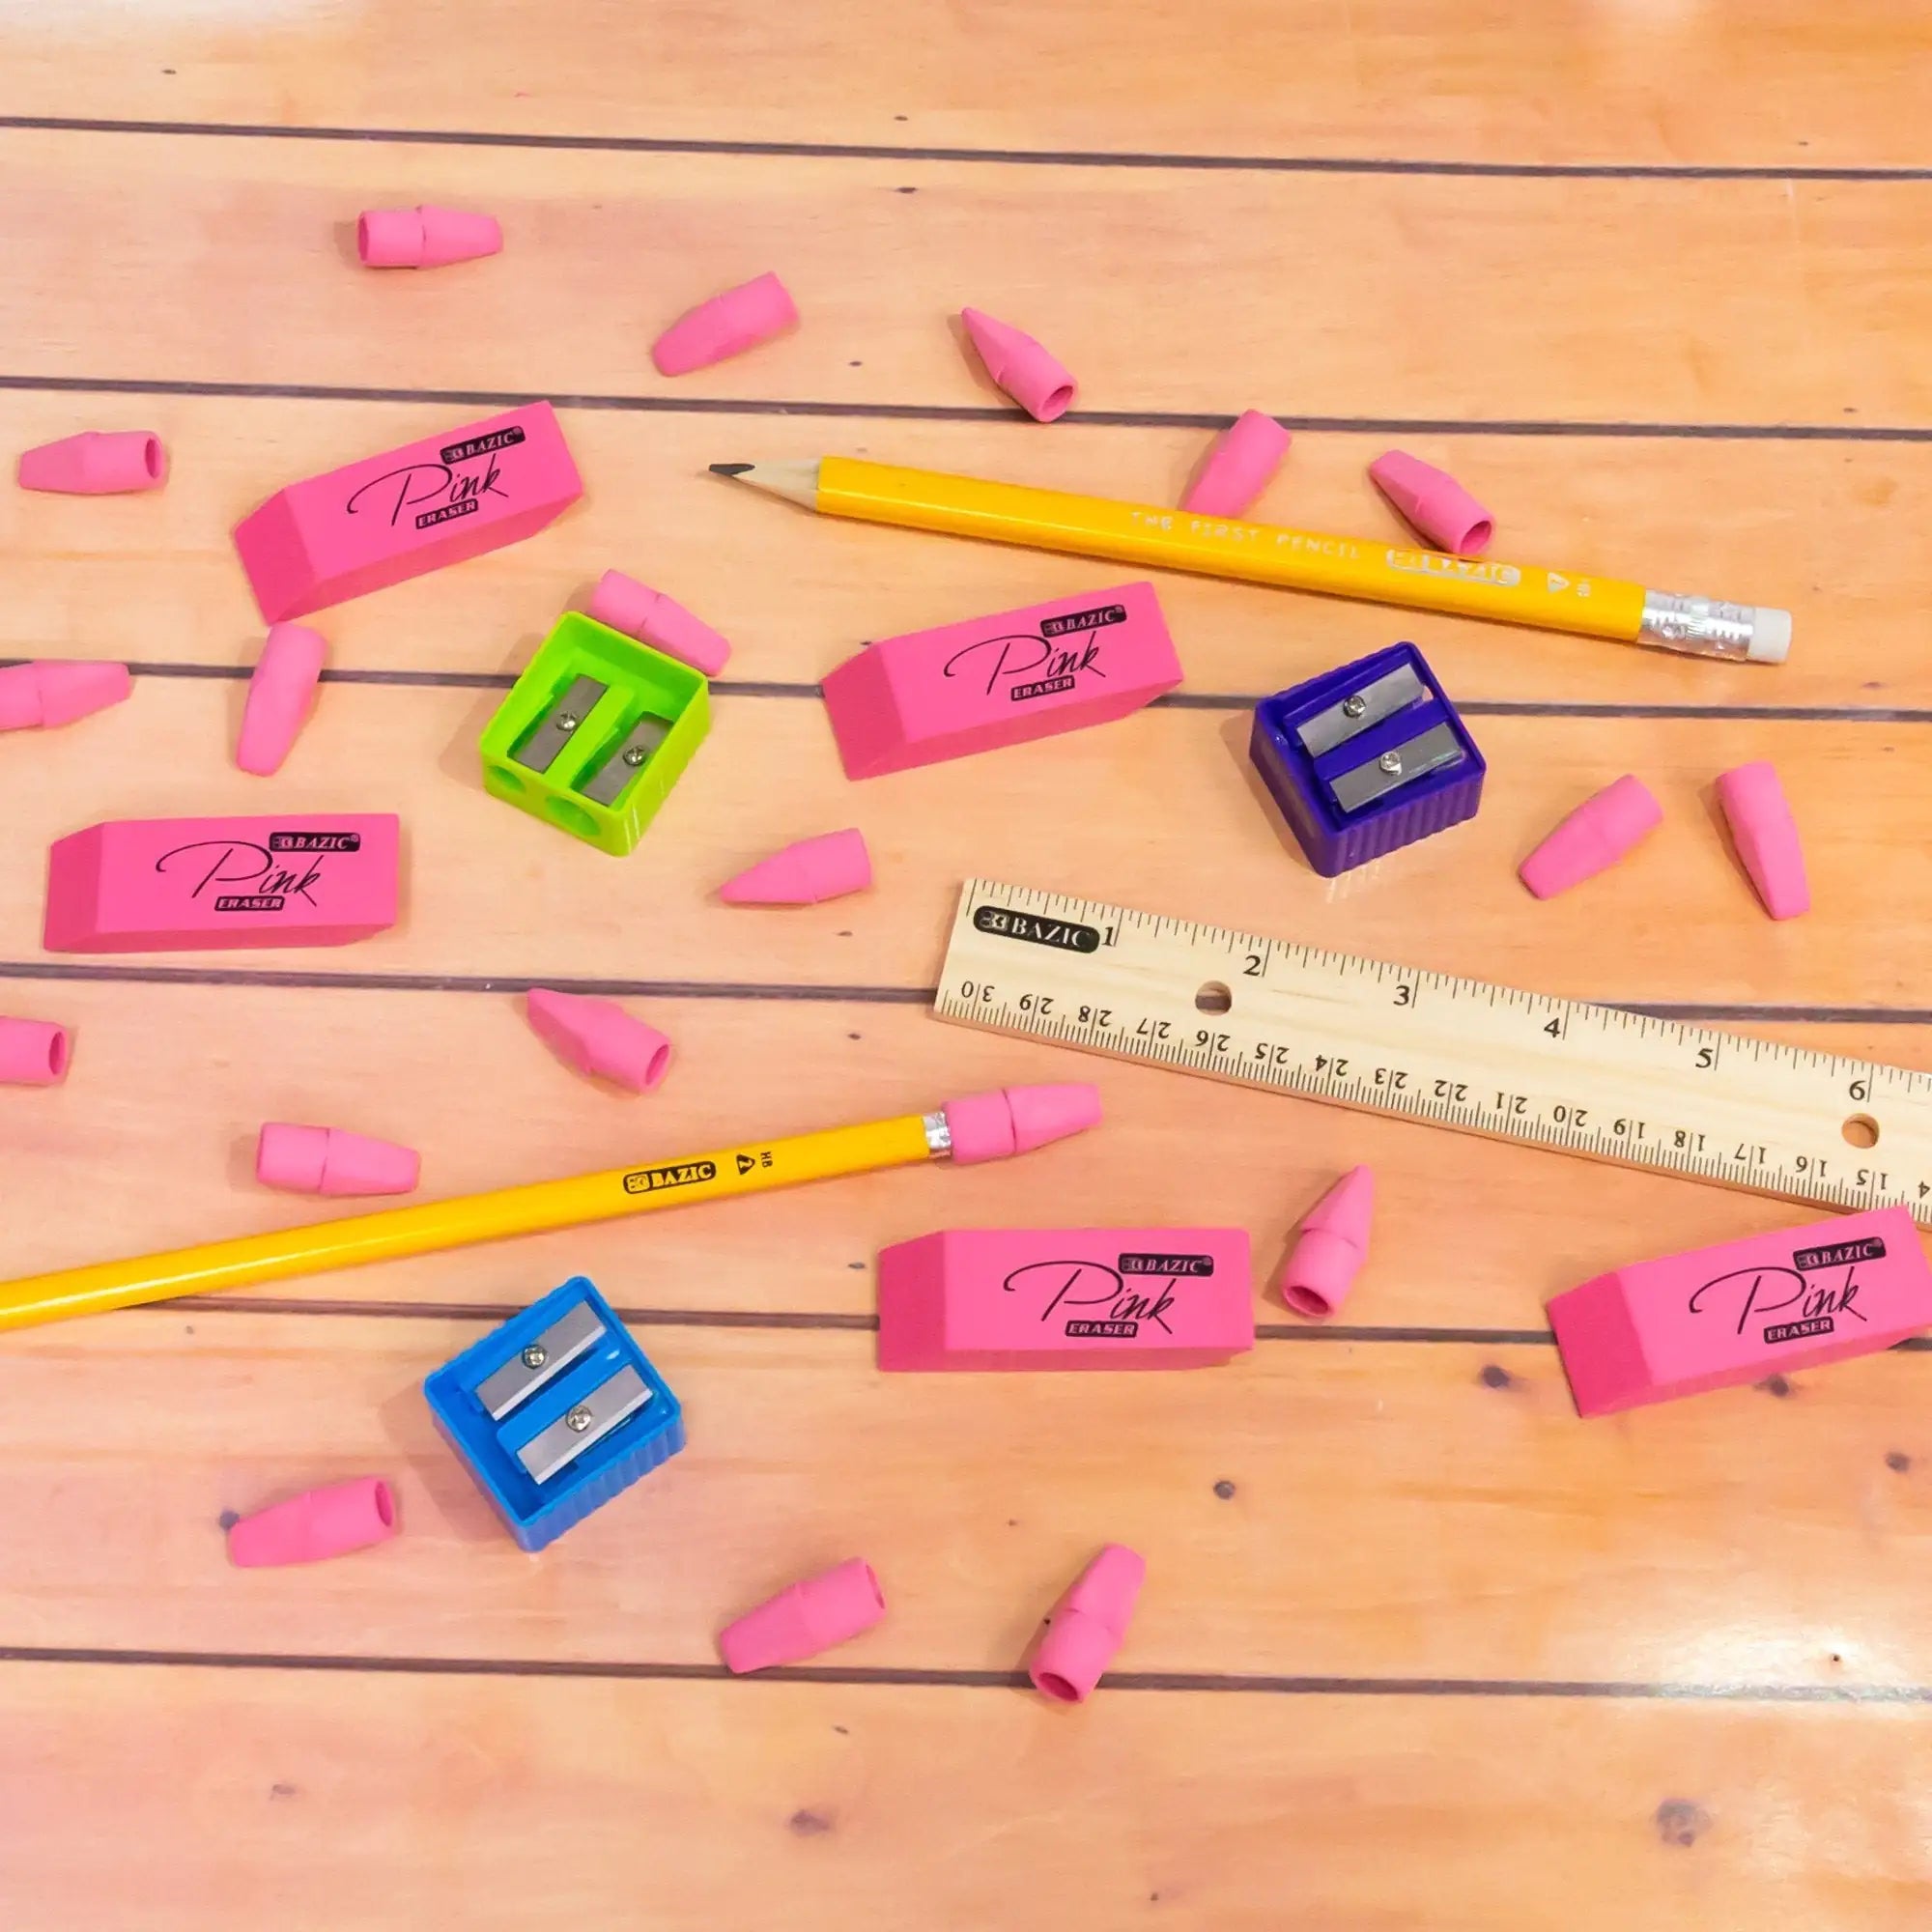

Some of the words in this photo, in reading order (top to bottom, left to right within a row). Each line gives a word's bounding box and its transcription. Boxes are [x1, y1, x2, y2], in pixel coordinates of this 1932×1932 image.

[347, 453, 509, 526] Pink
[417, 500, 476, 528] ERASER
[1190, 520, 1261, 542] FIRST
[1275, 533, 1360, 559] PENCIL
[943, 630, 1107, 696] Pink
[1013, 676, 1073, 699] ERASER
[156, 840, 325, 907] Pink
[217, 897, 282, 910] ERASER
[1011, 917, 1091, 948] BAZIC
[961, 980, 995, 1002] 30
[1019, 993, 1054, 1015] 29
[1100, 925, 1115, 947] 1
[1242, 954, 1262, 977] 2
[1392, 983, 1410, 1006] 3
[1543, 1017, 1561, 1038] 4
[1694, 1048, 1713, 1069] 5
[1849, 1080, 1866, 1100] 6
[1078, 1006, 1112, 1027] 28
[1136, 1017, 1171, 1038] 27
[1195, 1030, 1231, 1052] 26
[1254, 1042, 1290, 1065] 25
[1315, 1054, 1349, 1077] 24
[1375, 1067, 1408, 1090] 23
[1435, 1079, 1468, 1102] 22
[1496, 1092, 1528, 1114] 21
[1552, 1105, 1588, 1127] 20
[1613, 1118, 1646, 1140] 19
[1673, 1130, 1706, 1152] 18
[759, 1151, 774, 1168] HB
[1734, 1143, 1767, 1165] 17
[650, 1164, 713, 1188] BAZIC
[1795, 1155, 1828, 1178] 16
[1856, 1169, 1889, 1190] 15
[1003, 1260, 1177, 1335] Pink
[1689, 1265, 1867, 1335] Pink
[1068, 1321, 1136, 1336] ERASER
[1766, 1319, 1833, 1342] ERASER
